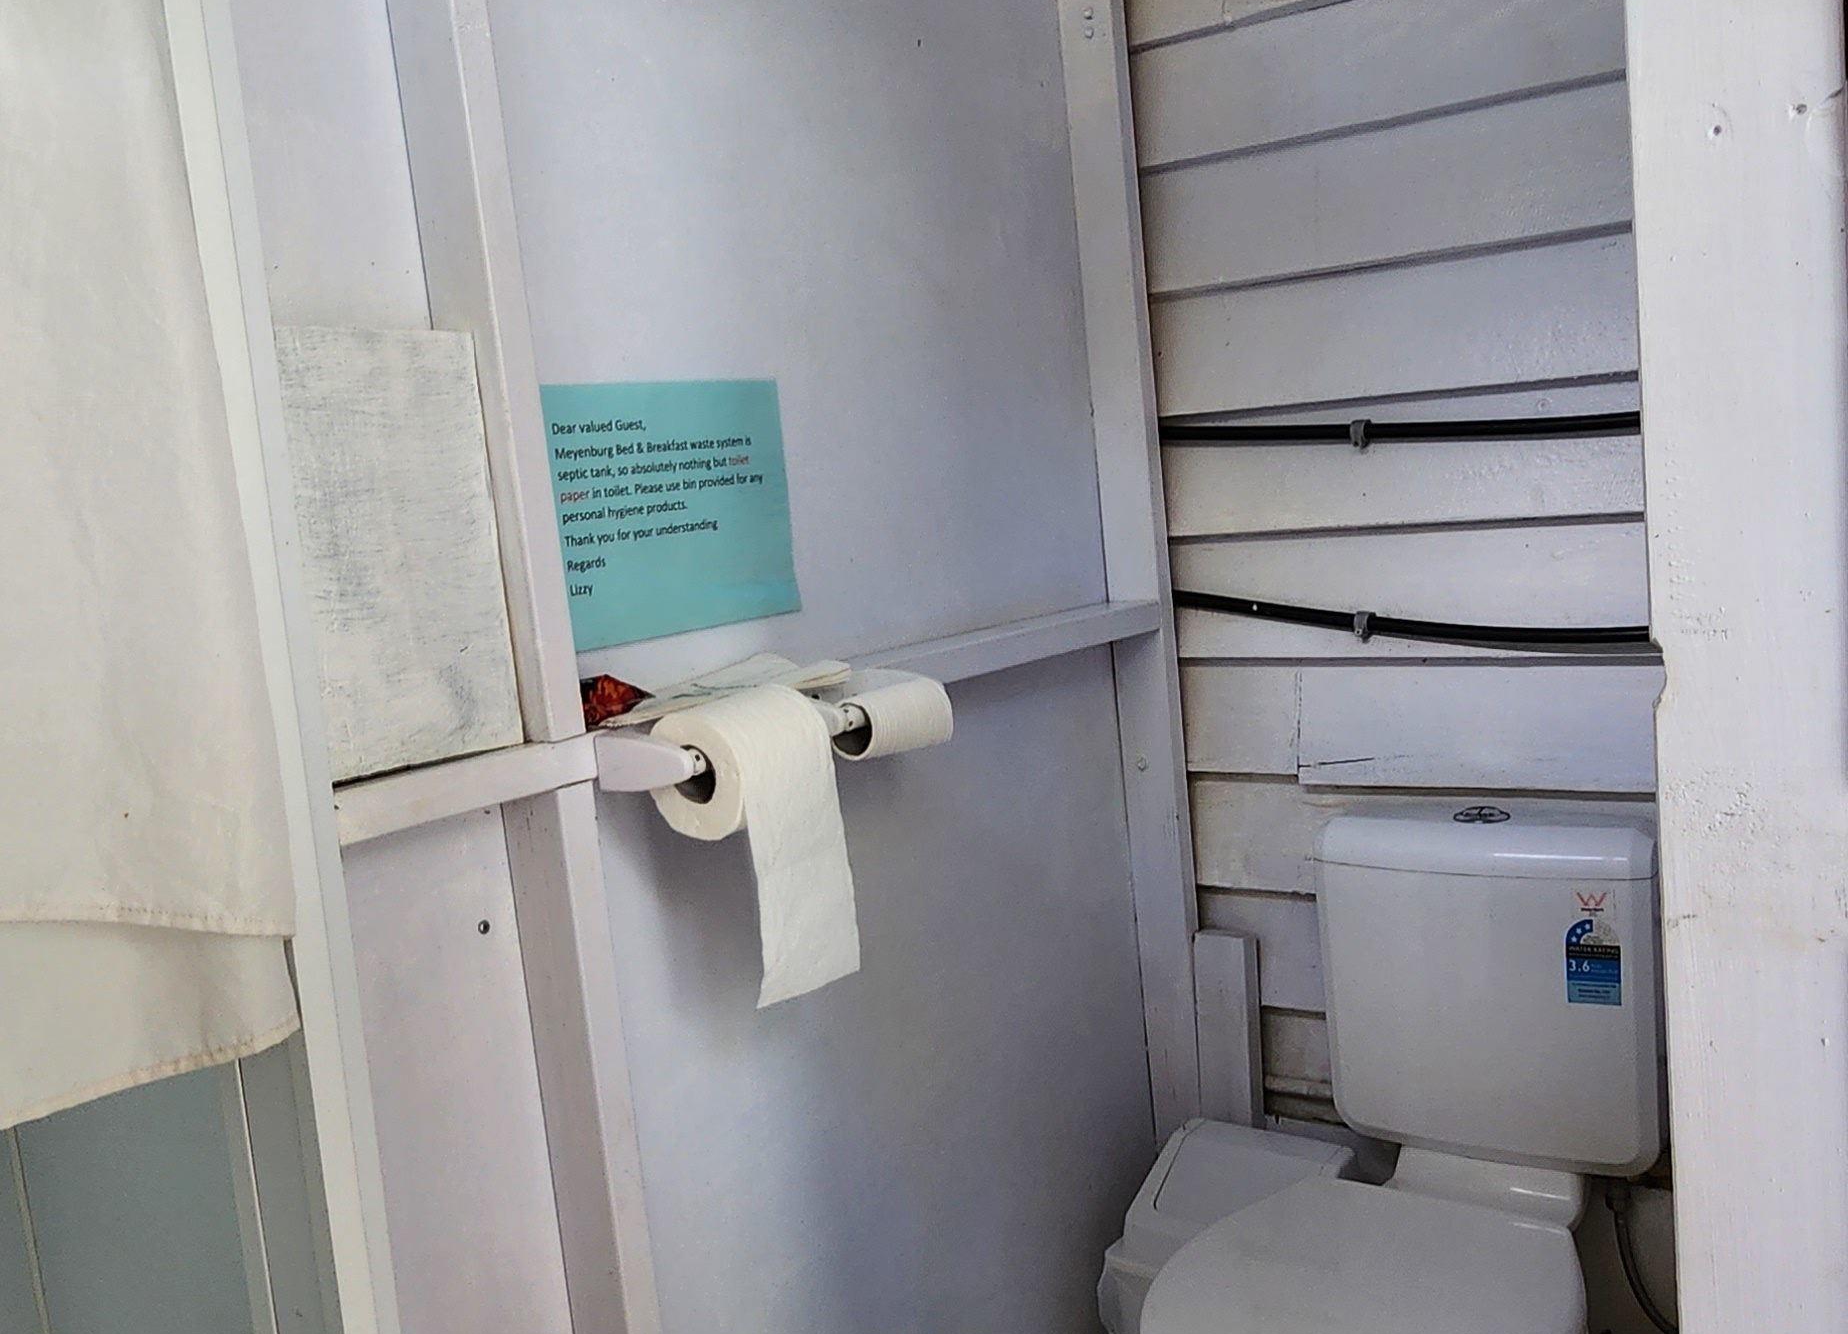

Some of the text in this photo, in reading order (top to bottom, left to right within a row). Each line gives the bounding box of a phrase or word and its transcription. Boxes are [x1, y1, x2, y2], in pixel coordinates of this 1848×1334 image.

[552, 419, 647, 435] Dear valued Guest,
[555, 436, 751, 461] Meyenburg Bed & Breakfast waste system is
[558, 455, 750, 483] septic tank, so absolutely nothing but toilet
[560, 474, 763, 504] paper in toilet. Please use bin provided for any
[562, 500, 687, 525] personal hygiene products.
[564, 519, 718, 548] Thank you for your understanding
[567, 556, 606, 573] Regards
[570, 583, 593, 597] Lizzy
[1568, 958, 1590, 973] 3.6
